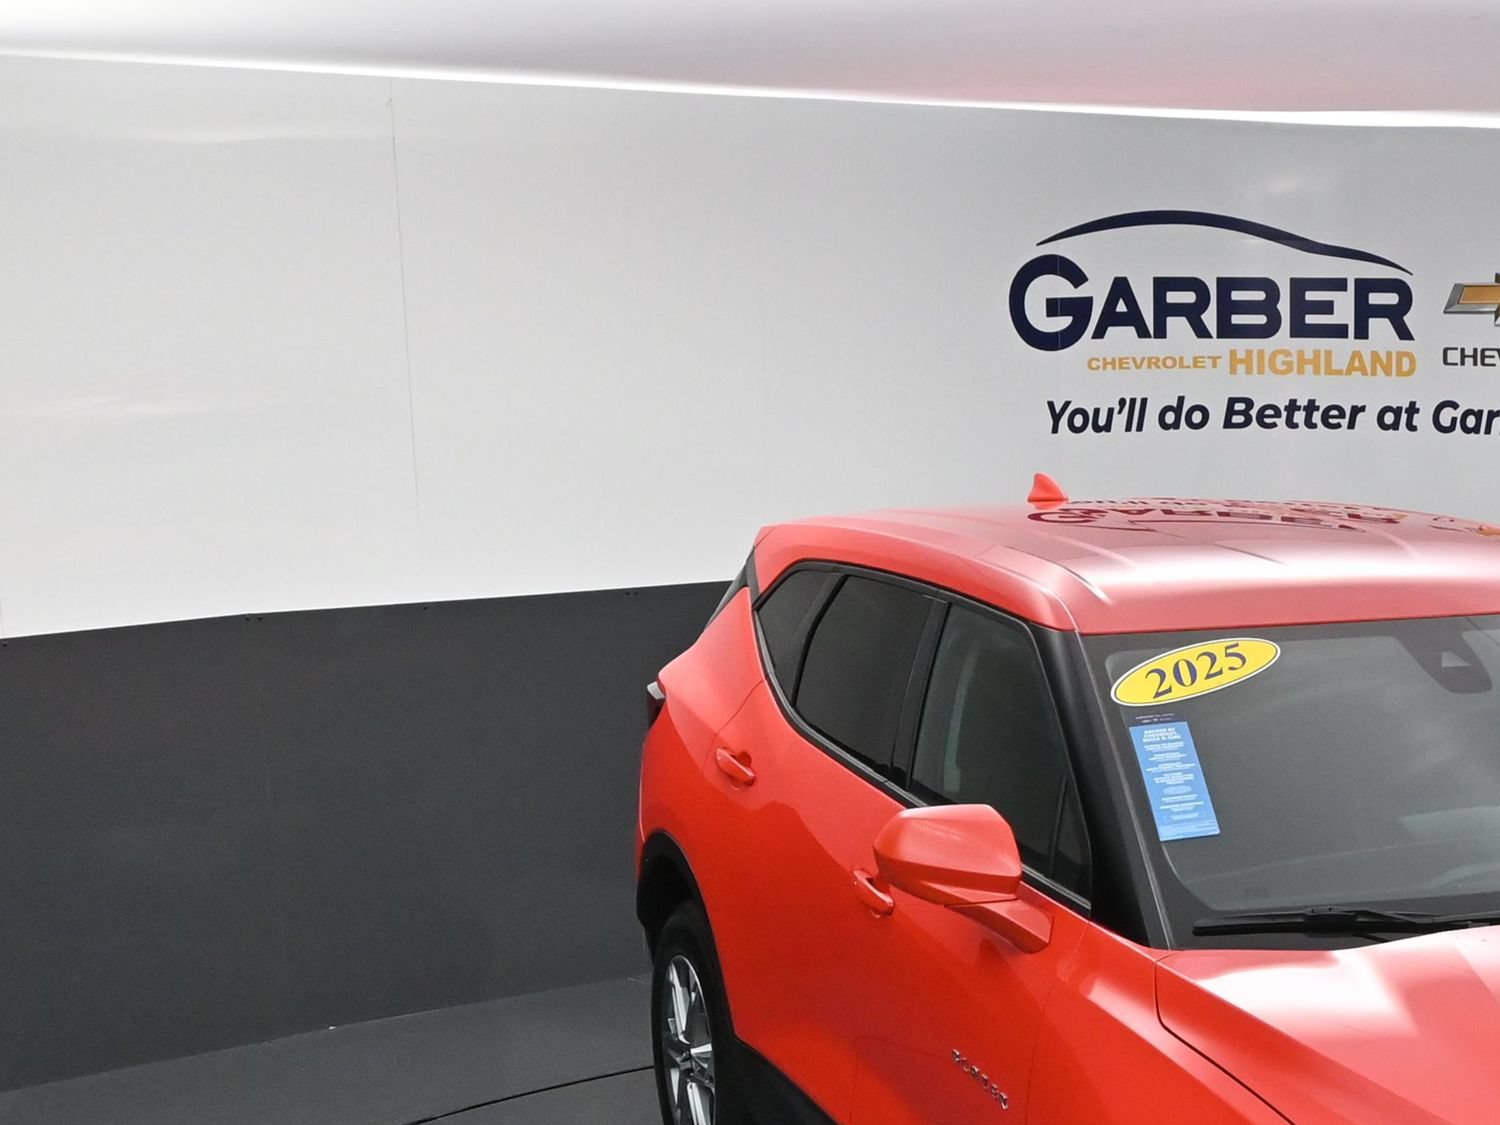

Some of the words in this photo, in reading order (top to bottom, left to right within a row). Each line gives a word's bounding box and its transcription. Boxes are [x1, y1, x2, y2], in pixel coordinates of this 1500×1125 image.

[1009, 253, 1415, 352] GARBER
[1087, 355, 1222, 371] CHEVROLET
[1229, 348, 1417, 377] HIGHLAND
[1158, 395, 1210, 431] do
[1222, 396, 1366, 431] Better
[1376, 400, 1420, 432] at
[1144, 642, 1247, 699] 2025
